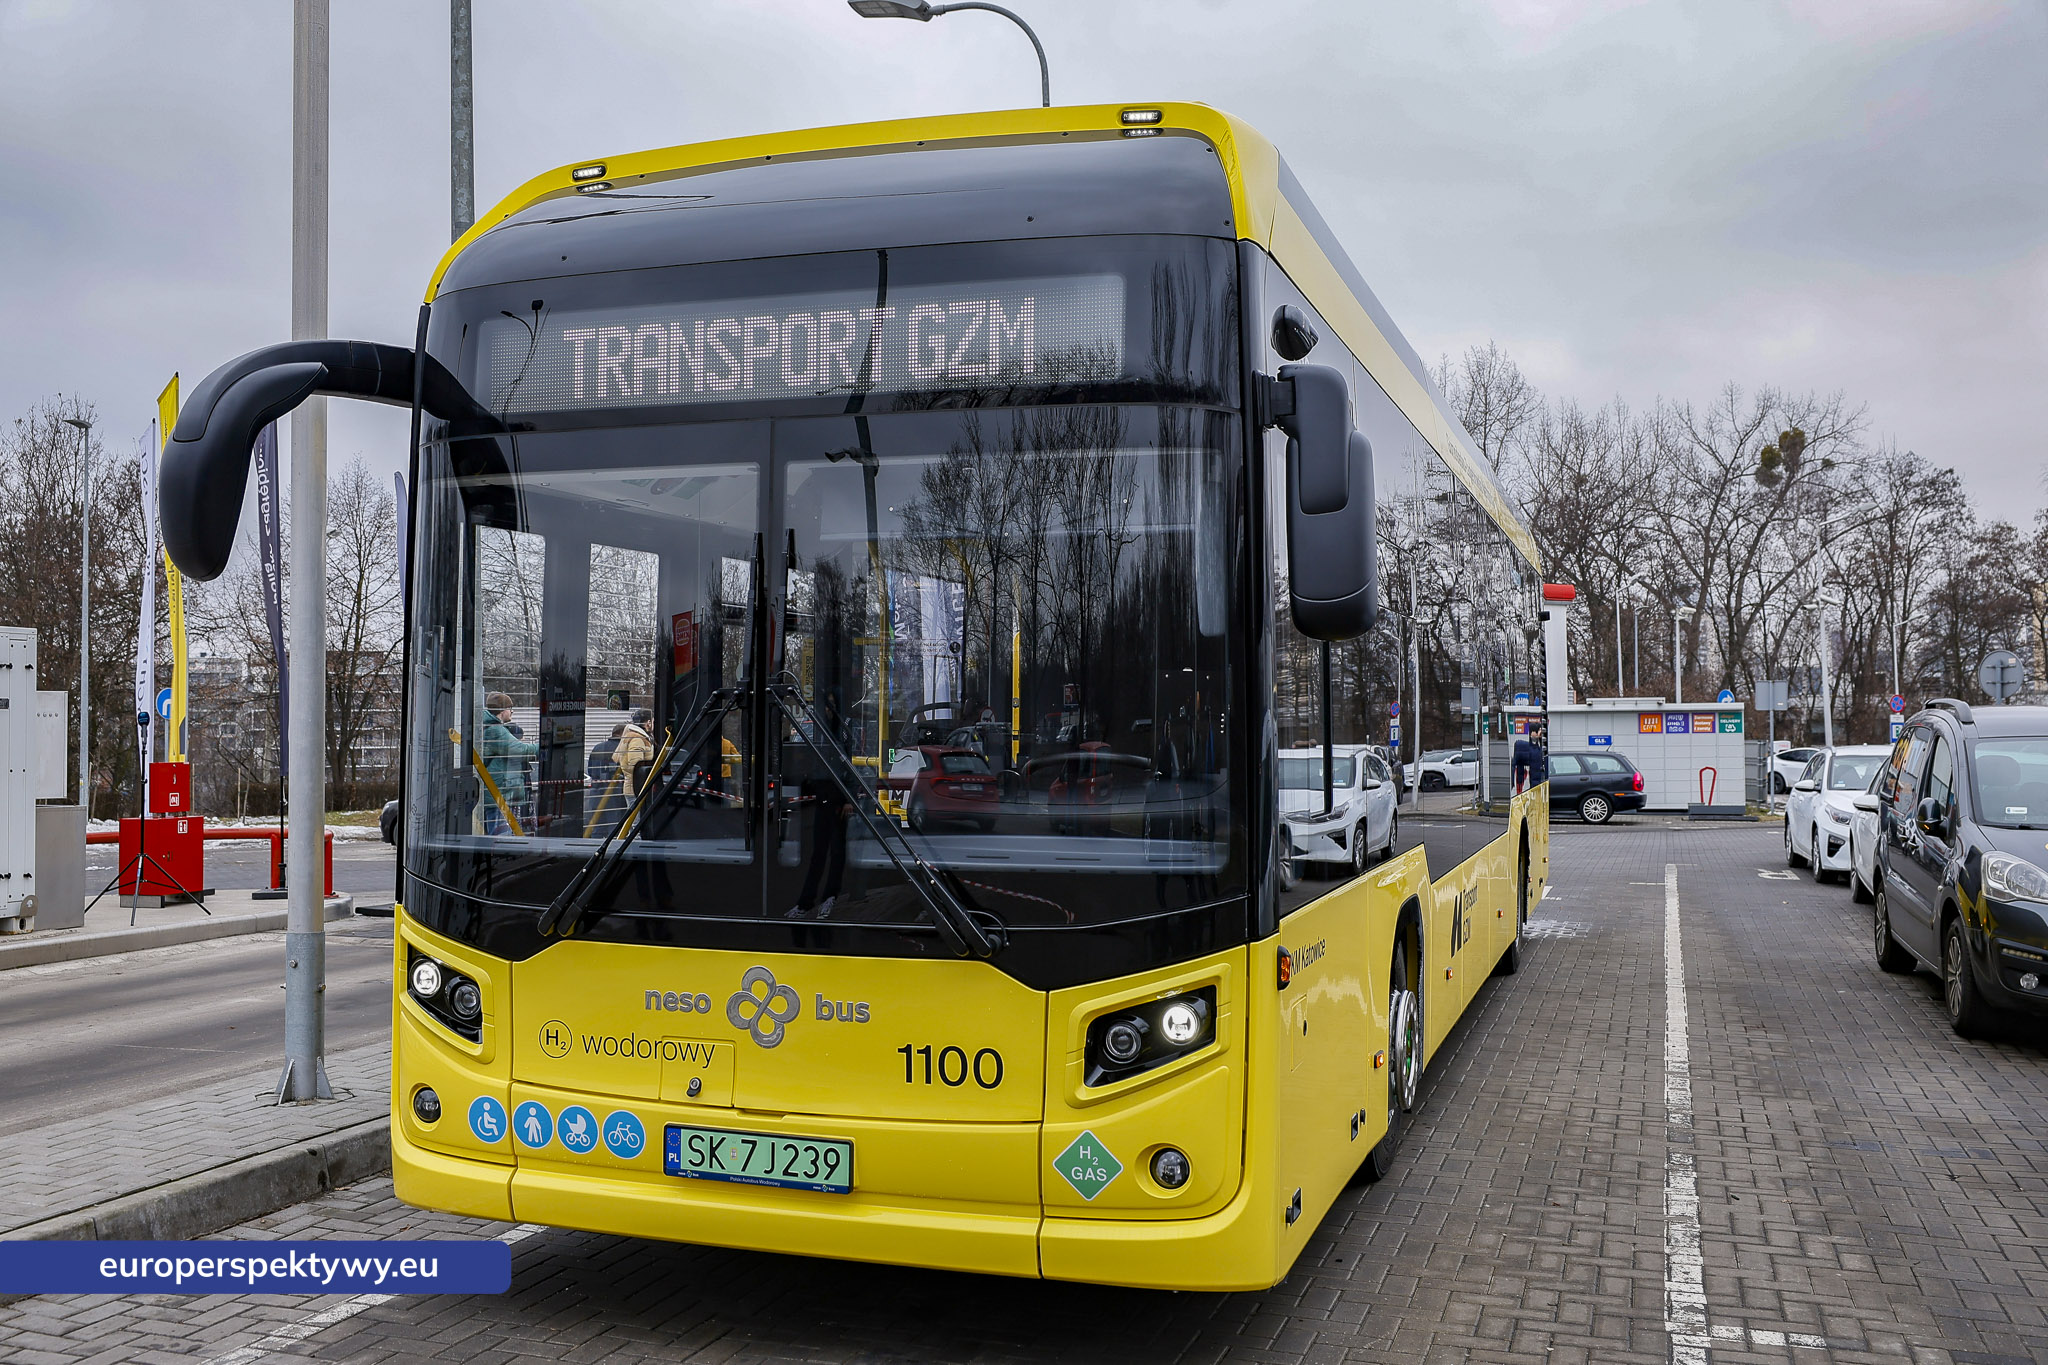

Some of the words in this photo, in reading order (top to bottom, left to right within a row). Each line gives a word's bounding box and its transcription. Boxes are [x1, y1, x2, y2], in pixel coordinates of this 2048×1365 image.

[563, 306, 896, 400] TRANSPORT
[907, 296, 1036, 380] GZM
[1301, 936, 1326, 970] Katowice
[644, 989, 712, 1015] neso
[815, 993, 871, 1024] bus
[581, 1031, 716, 1069] wodorowy
[897, 1043, 1004, 1090] 1100
[668, 1152, 680, 1164] PL
[687, 1134, 727, 1171] SK
[759, 1179, 781, 1187] Wodorowy
[1071, 1166, 1108, 1182] GAS
